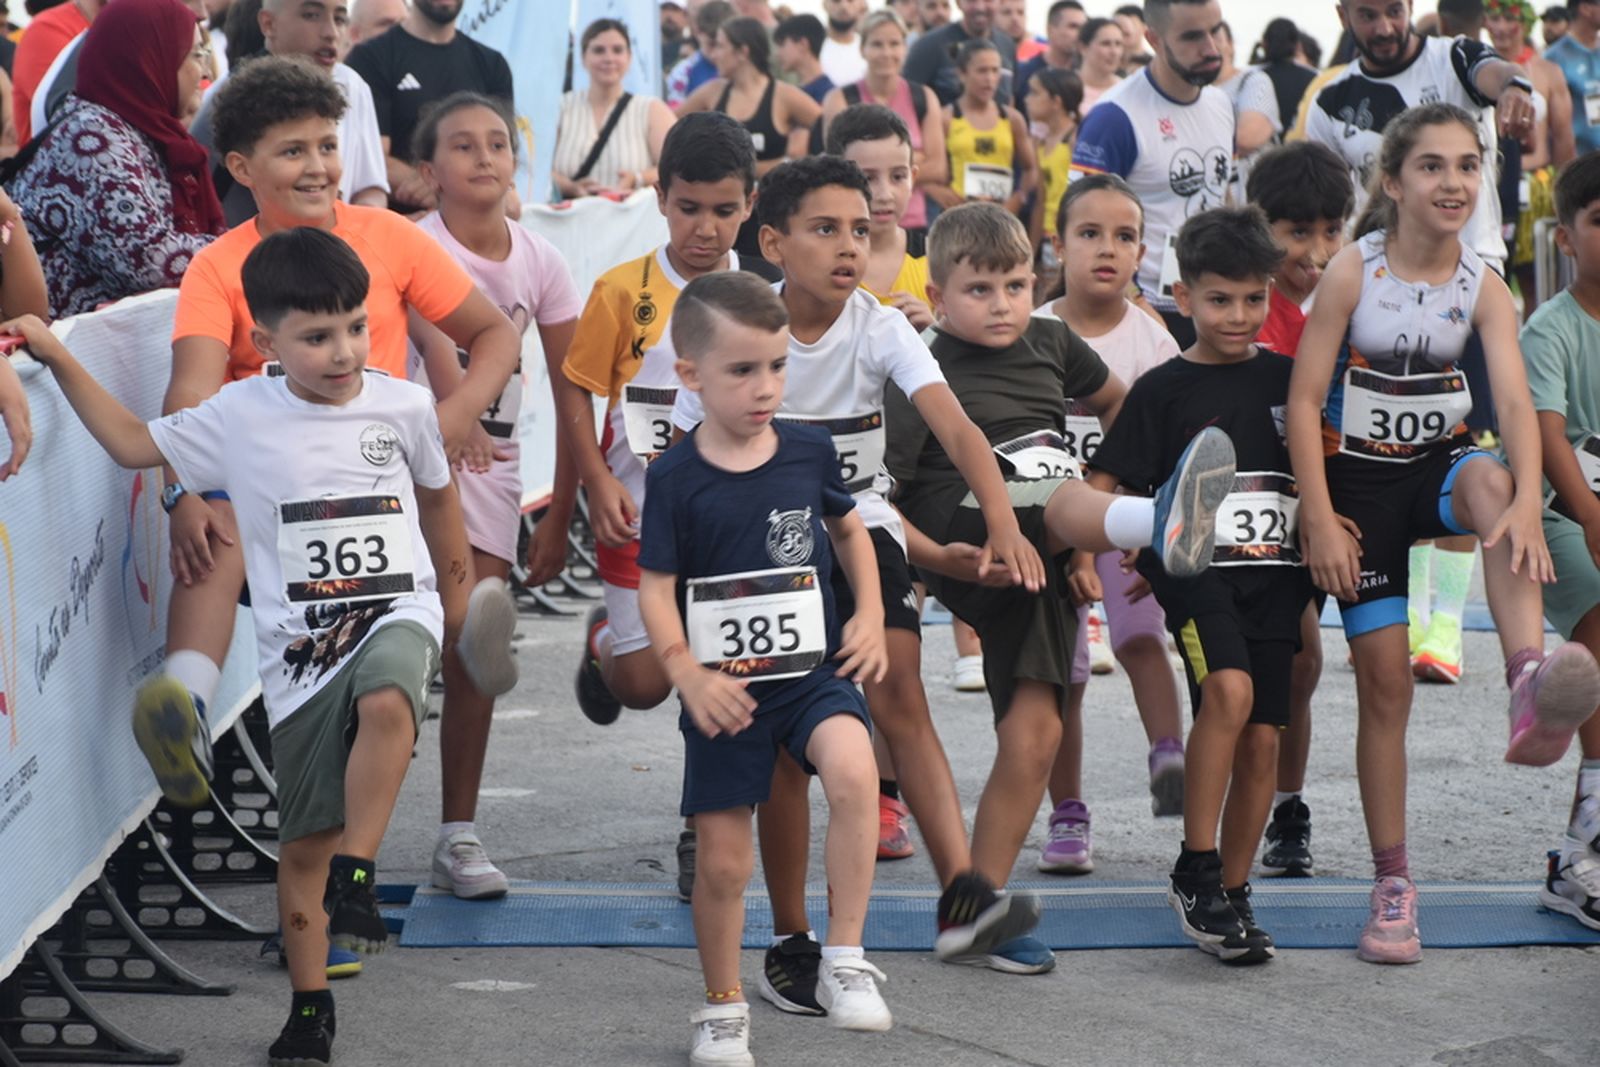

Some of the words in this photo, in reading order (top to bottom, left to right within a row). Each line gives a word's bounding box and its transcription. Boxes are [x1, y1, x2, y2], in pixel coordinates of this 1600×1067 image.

[1368, 408, 1446, 443] 309
[306, 534, 389, 579] 363
[720, 613, 801, 657] 385
